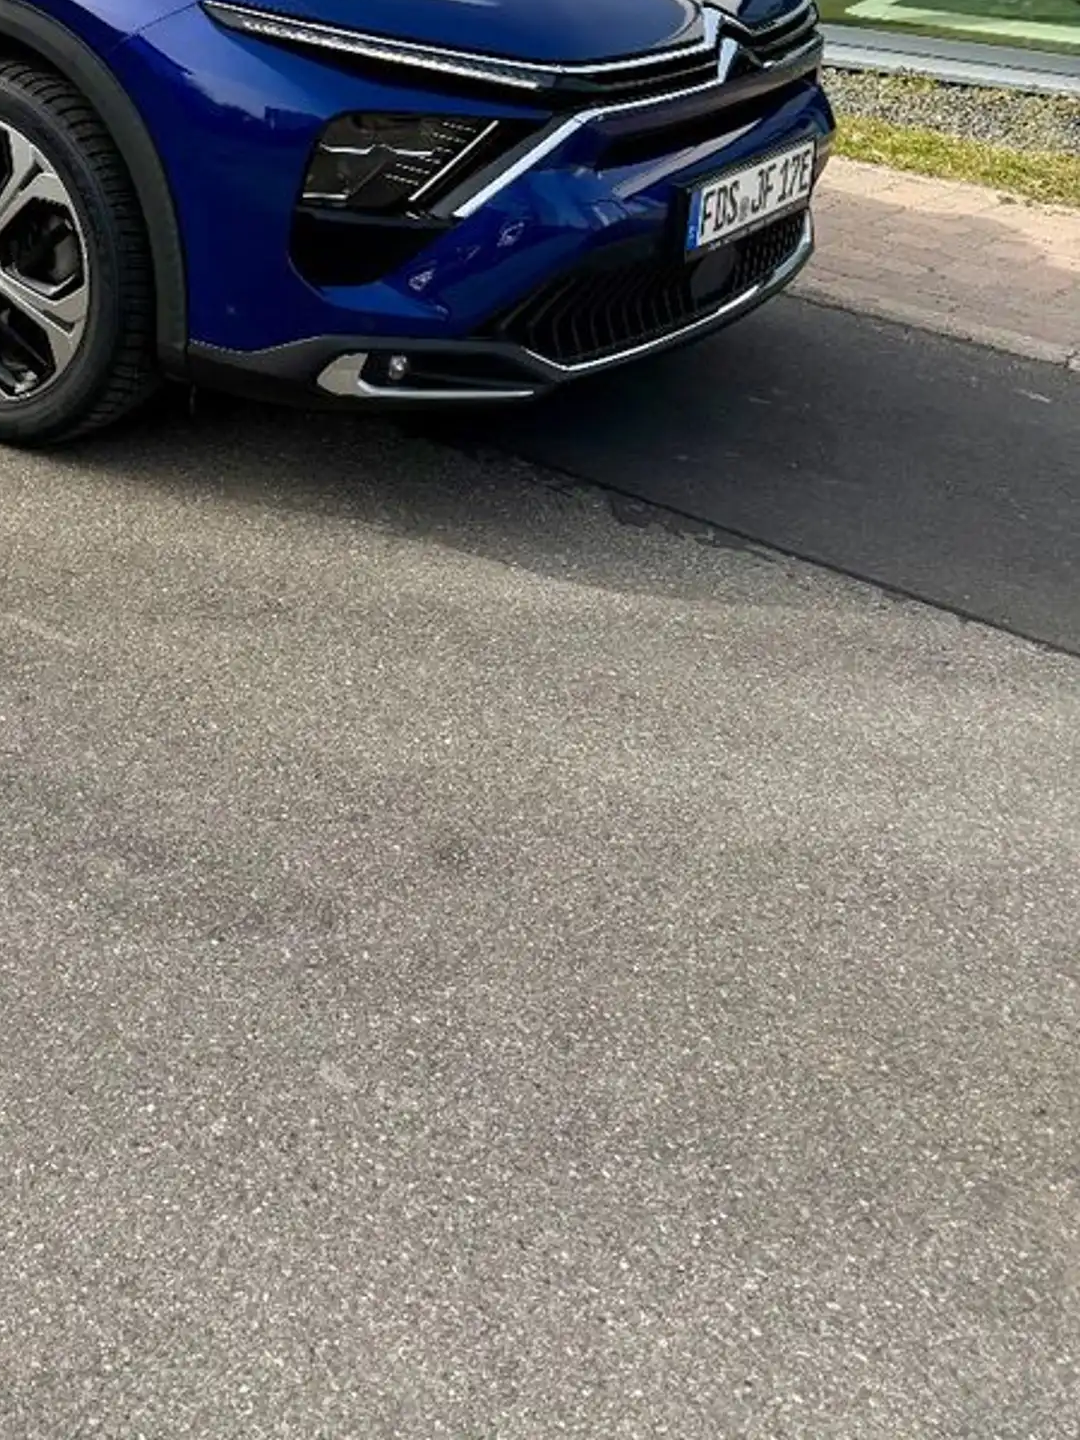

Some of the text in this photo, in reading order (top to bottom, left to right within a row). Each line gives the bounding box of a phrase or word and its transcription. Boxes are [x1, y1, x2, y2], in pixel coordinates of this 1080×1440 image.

[700, 179, 740, 237] FDS
[750, 163, 777, 214] JF
[777, 148, 811, 203] 17E
